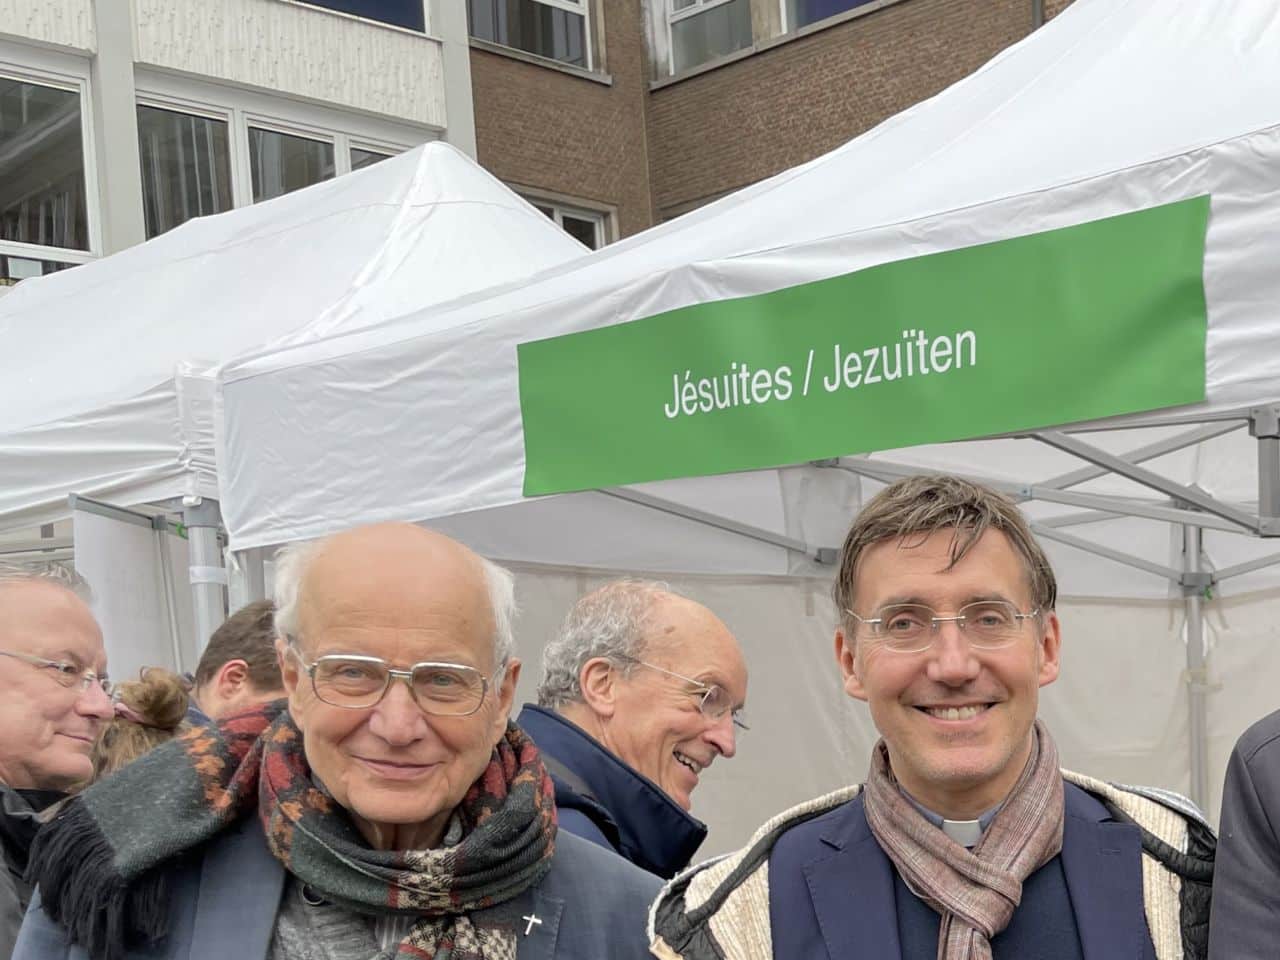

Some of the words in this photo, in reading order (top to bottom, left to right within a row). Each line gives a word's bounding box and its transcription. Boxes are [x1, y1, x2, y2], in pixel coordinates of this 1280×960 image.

[664, 362, 793, 418] Jésuites
[803, 349, 814, 396] /
[823, 329, 976, 392] Jezuïten
